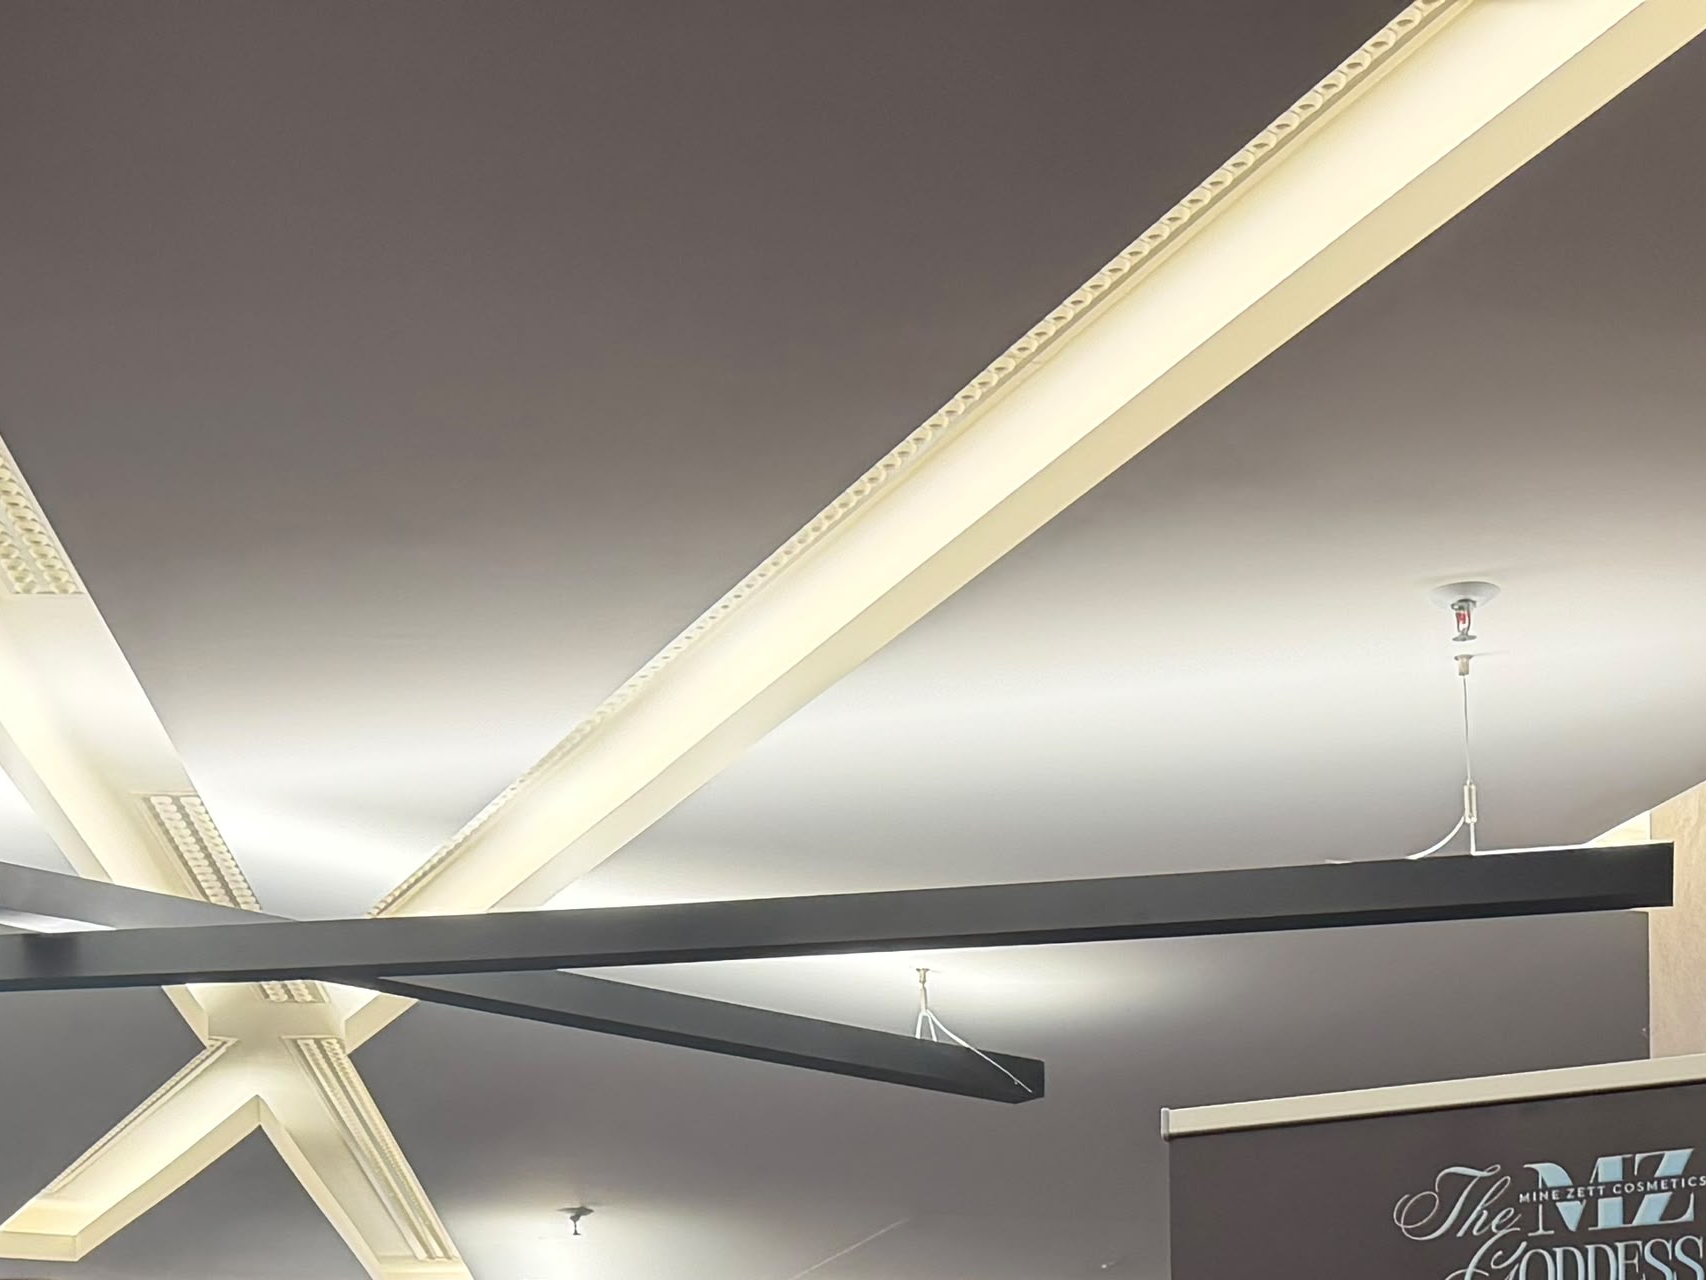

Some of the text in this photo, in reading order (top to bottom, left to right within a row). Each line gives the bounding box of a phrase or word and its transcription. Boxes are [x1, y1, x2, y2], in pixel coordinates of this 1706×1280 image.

[1393, 1164, 1522, 1240] The
[1519, 1190, 1560, 1203] MINE
[1566, 1185, 1605, 1199] ZETT
